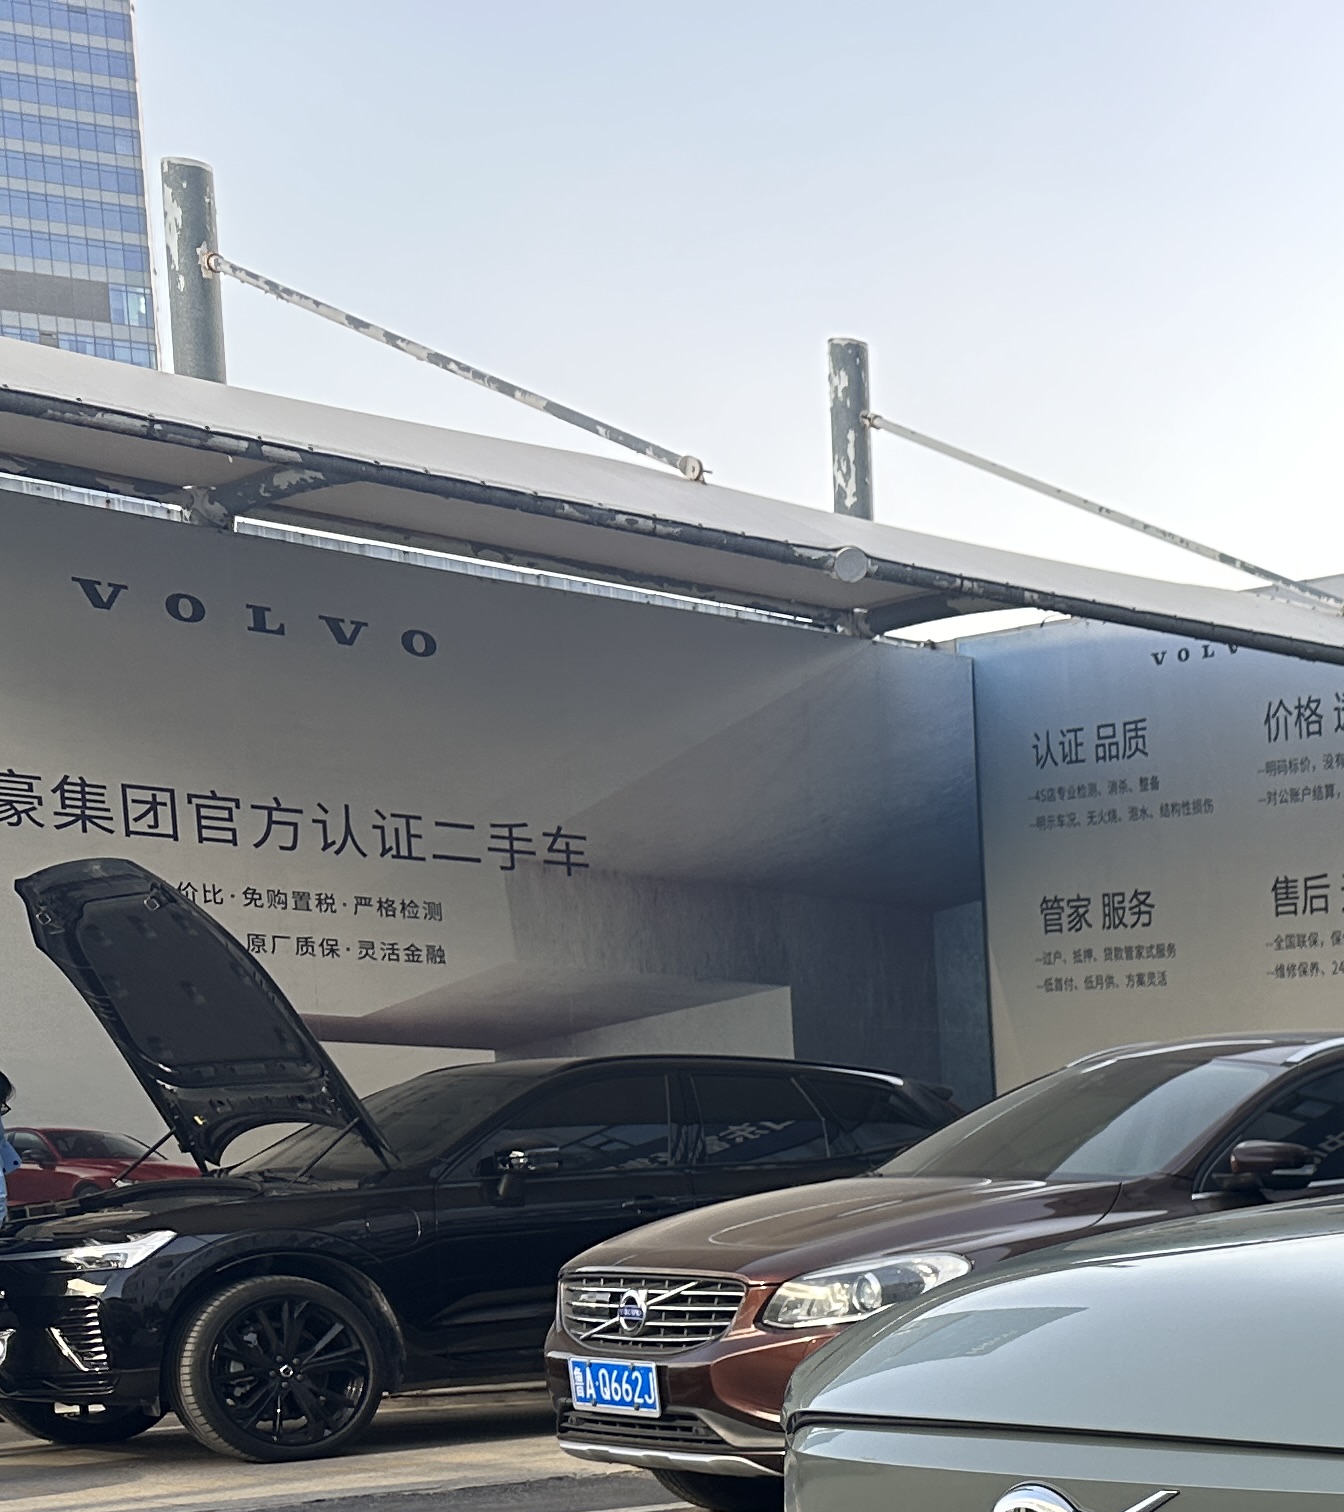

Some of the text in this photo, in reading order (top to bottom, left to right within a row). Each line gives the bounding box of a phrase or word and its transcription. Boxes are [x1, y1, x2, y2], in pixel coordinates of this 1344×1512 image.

[71, 575, 438, 658] VOLVO
[1032, 718, 1149, 770] 认证 品质
[1264, 695, 1324, 743] 价格
[0, 768, 590, 877] 豪集团官方认证二手车
[1040, 888, 1155, 936] 管家 服务
[1271, 873, 1330, 918] 售后
